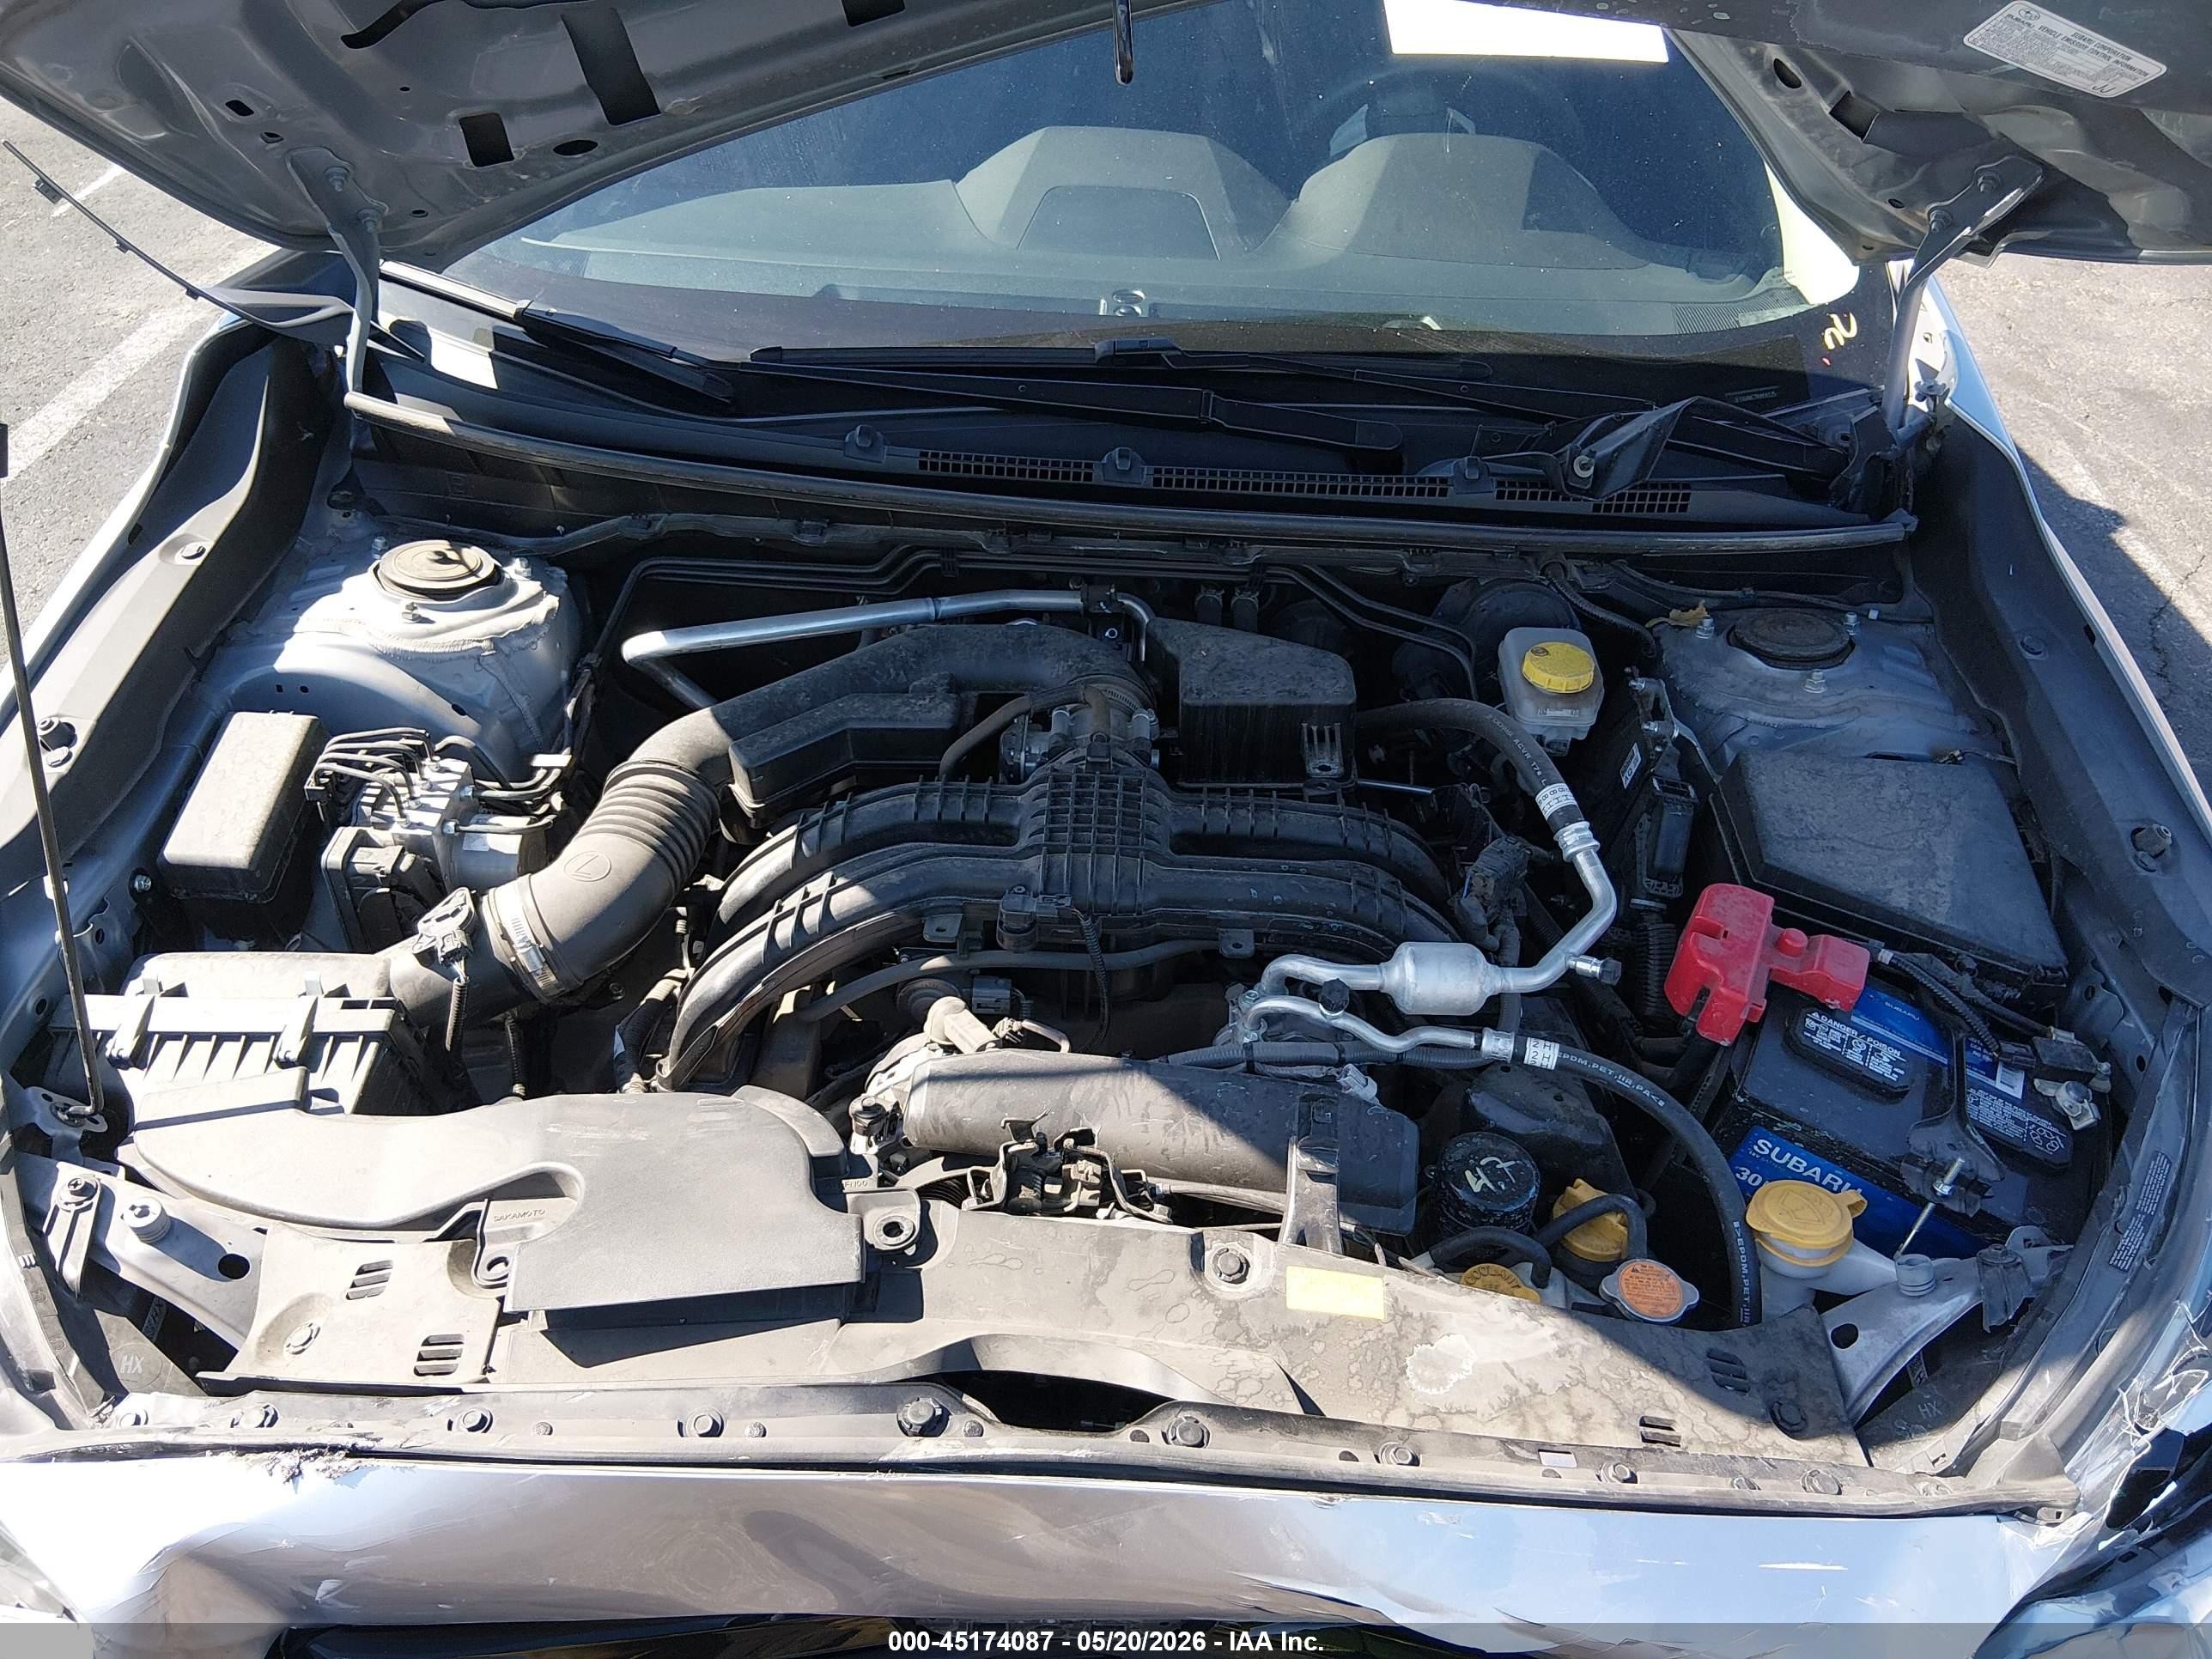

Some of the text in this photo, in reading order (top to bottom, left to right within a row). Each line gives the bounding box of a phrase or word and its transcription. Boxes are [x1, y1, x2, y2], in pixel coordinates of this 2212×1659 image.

[1884, 1001, 1920, 1021] SUBARU
[1820, 1015, 1859, 1036] DANGER
[1867, 1036, 1901, 1057] POISON
[1735, 1165, 1769, 1187] 30
[494, 1209, 545, 1222] SAKAMOTO
[120, 1354, 145, 1374] HX
